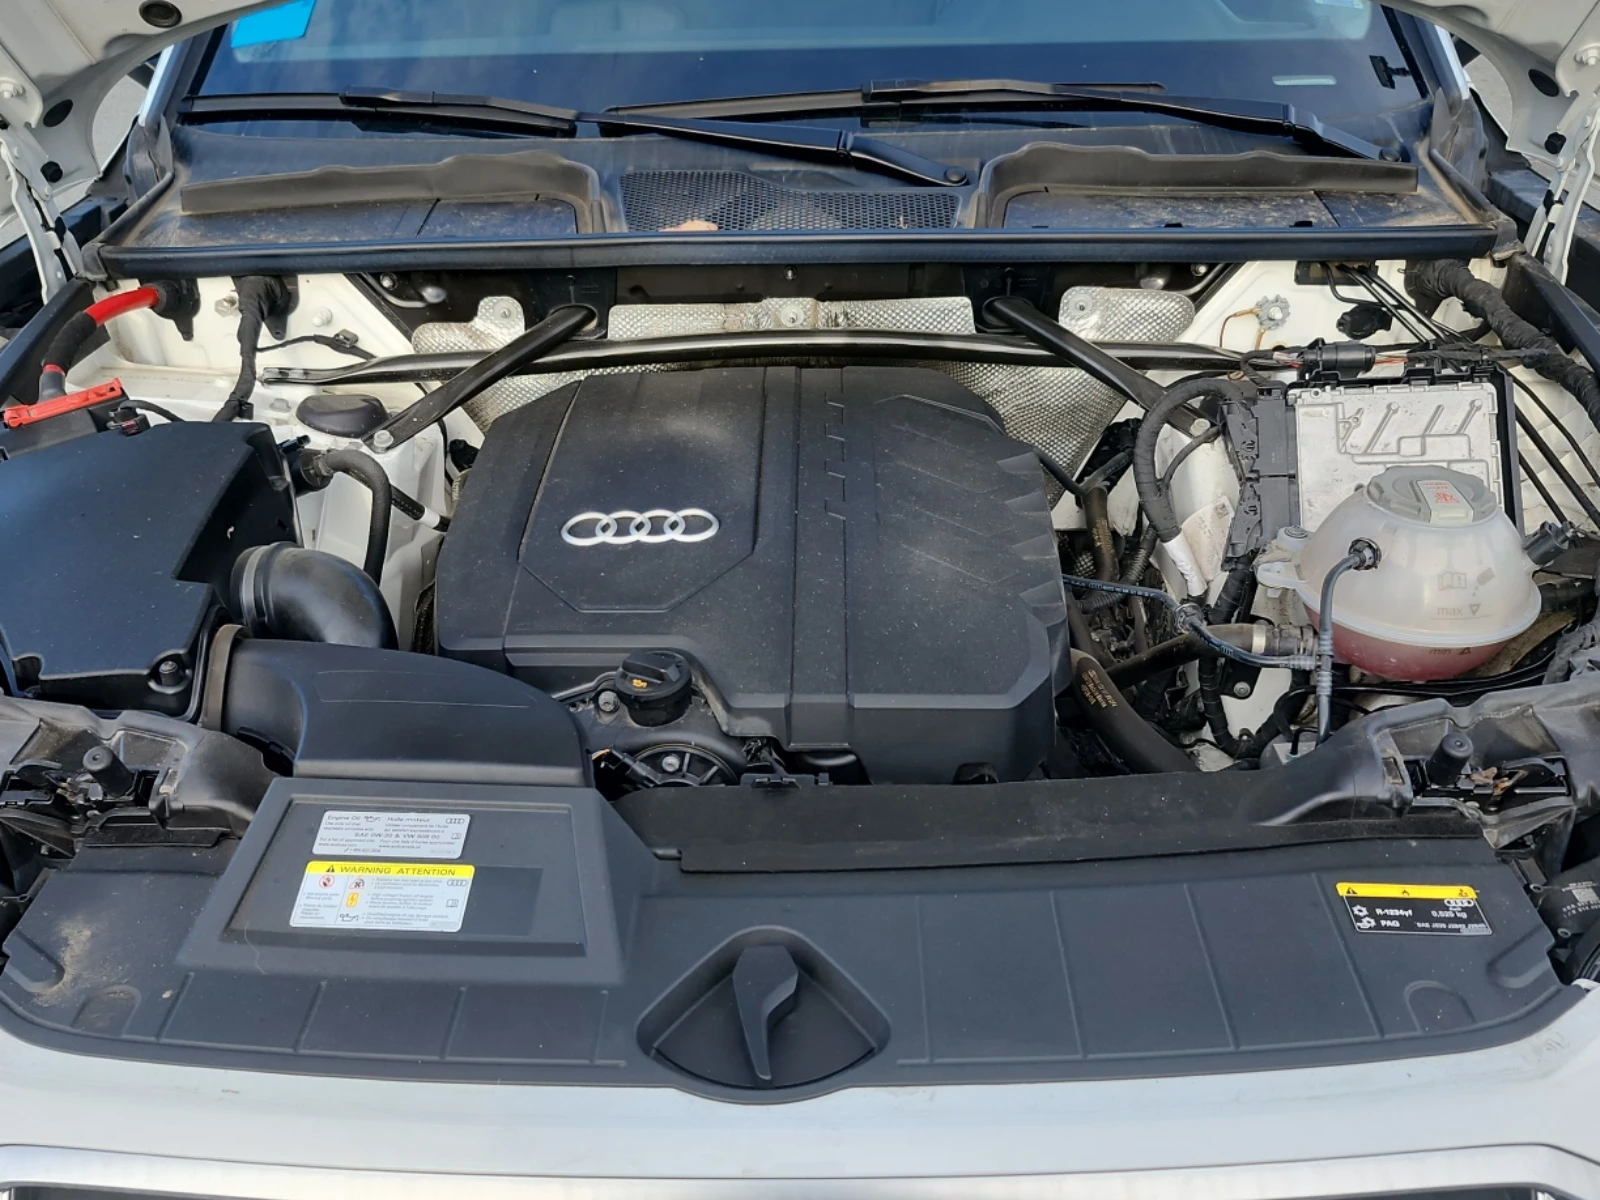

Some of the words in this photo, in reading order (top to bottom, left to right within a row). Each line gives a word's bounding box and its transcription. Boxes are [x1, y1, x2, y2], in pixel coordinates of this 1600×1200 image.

[1437, 607, 1464, 616] max
[340, 866, 392, 874] WARNING
[397, 867, 456, 876] ATTENTION
[1375, 908, 1413, 918] R-1234yf
[1380, 919, 1400, 927] PAG
